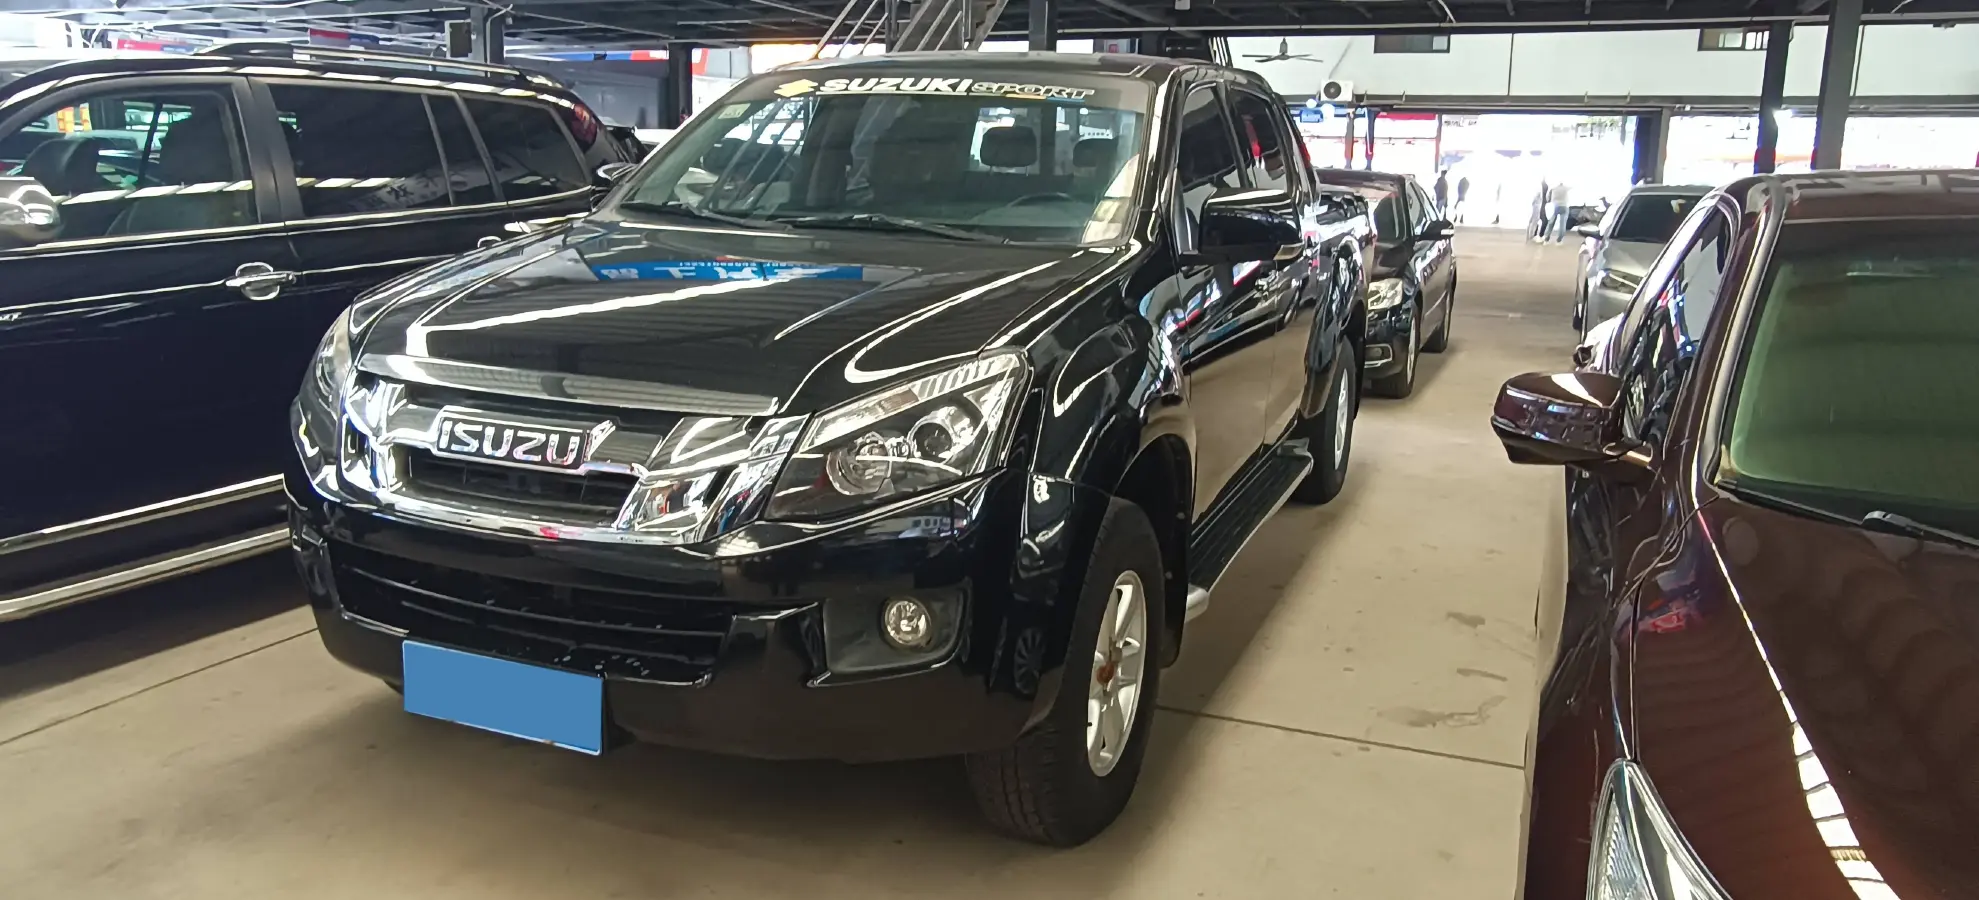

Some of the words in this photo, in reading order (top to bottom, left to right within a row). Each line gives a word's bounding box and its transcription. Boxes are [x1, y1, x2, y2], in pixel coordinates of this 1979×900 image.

[819, 77, 973, 93] SUZUKI
[971, 81, 1095, 99] SPORT
[438, 420, 581, 466] ISUZU
